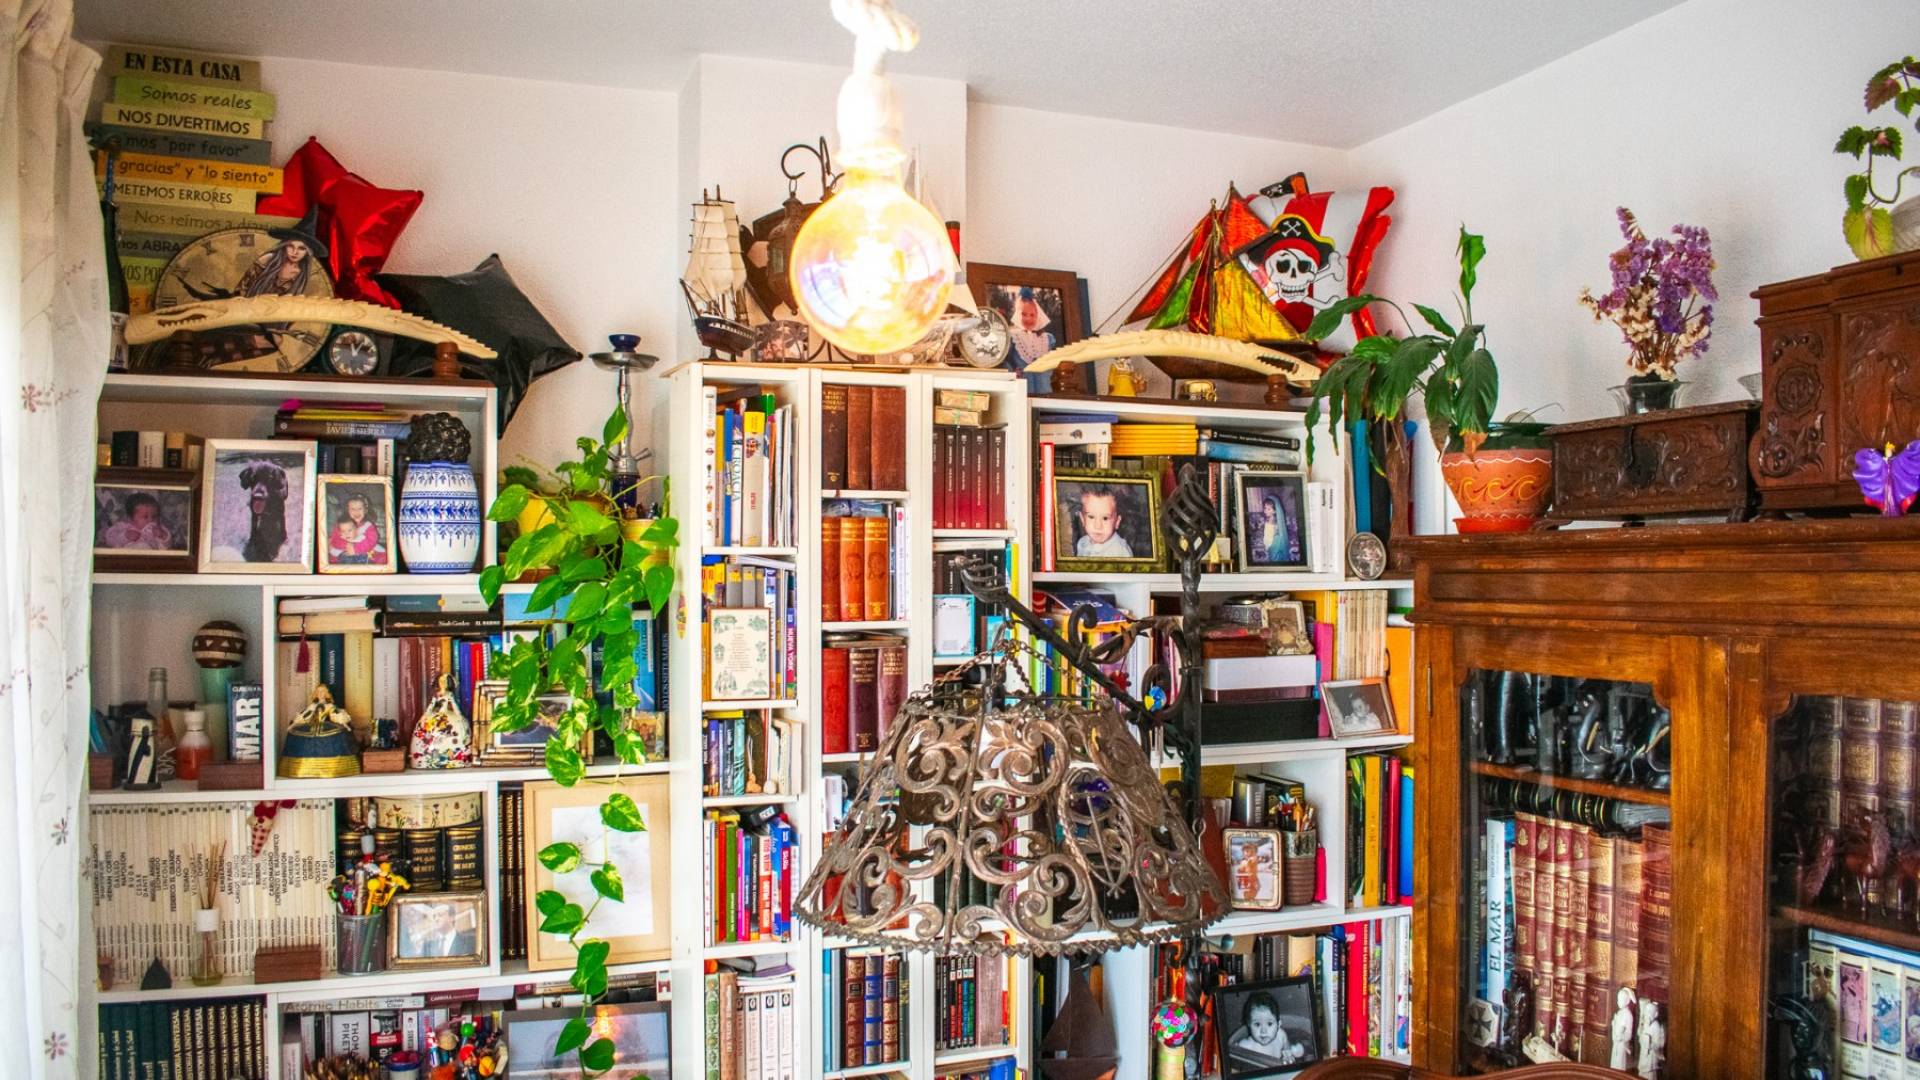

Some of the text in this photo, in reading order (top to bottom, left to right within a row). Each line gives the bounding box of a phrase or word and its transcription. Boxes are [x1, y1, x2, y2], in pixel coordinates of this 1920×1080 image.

[124, 52, 241, 82] EN ESTA CASA
[142, 85, 252, 110] Somos reales
[118, 109, 250, 135] NOS DIVERTIMOS
[185, 167, 194, 179] y
[179, 188, 233, 204] ERRORES
[134, 209, 166, 225] Nos
[732, 447, 742, 502] CROACIA
[236, 698, 261, 760] MAR
[1488, 900, 1502, 973] EL MAR
[286, 997, 380, 1013] Atomic Habits
[342, 1023, 350, 1056] PIKET
[351, 1022, 359, 1058] THOMA
